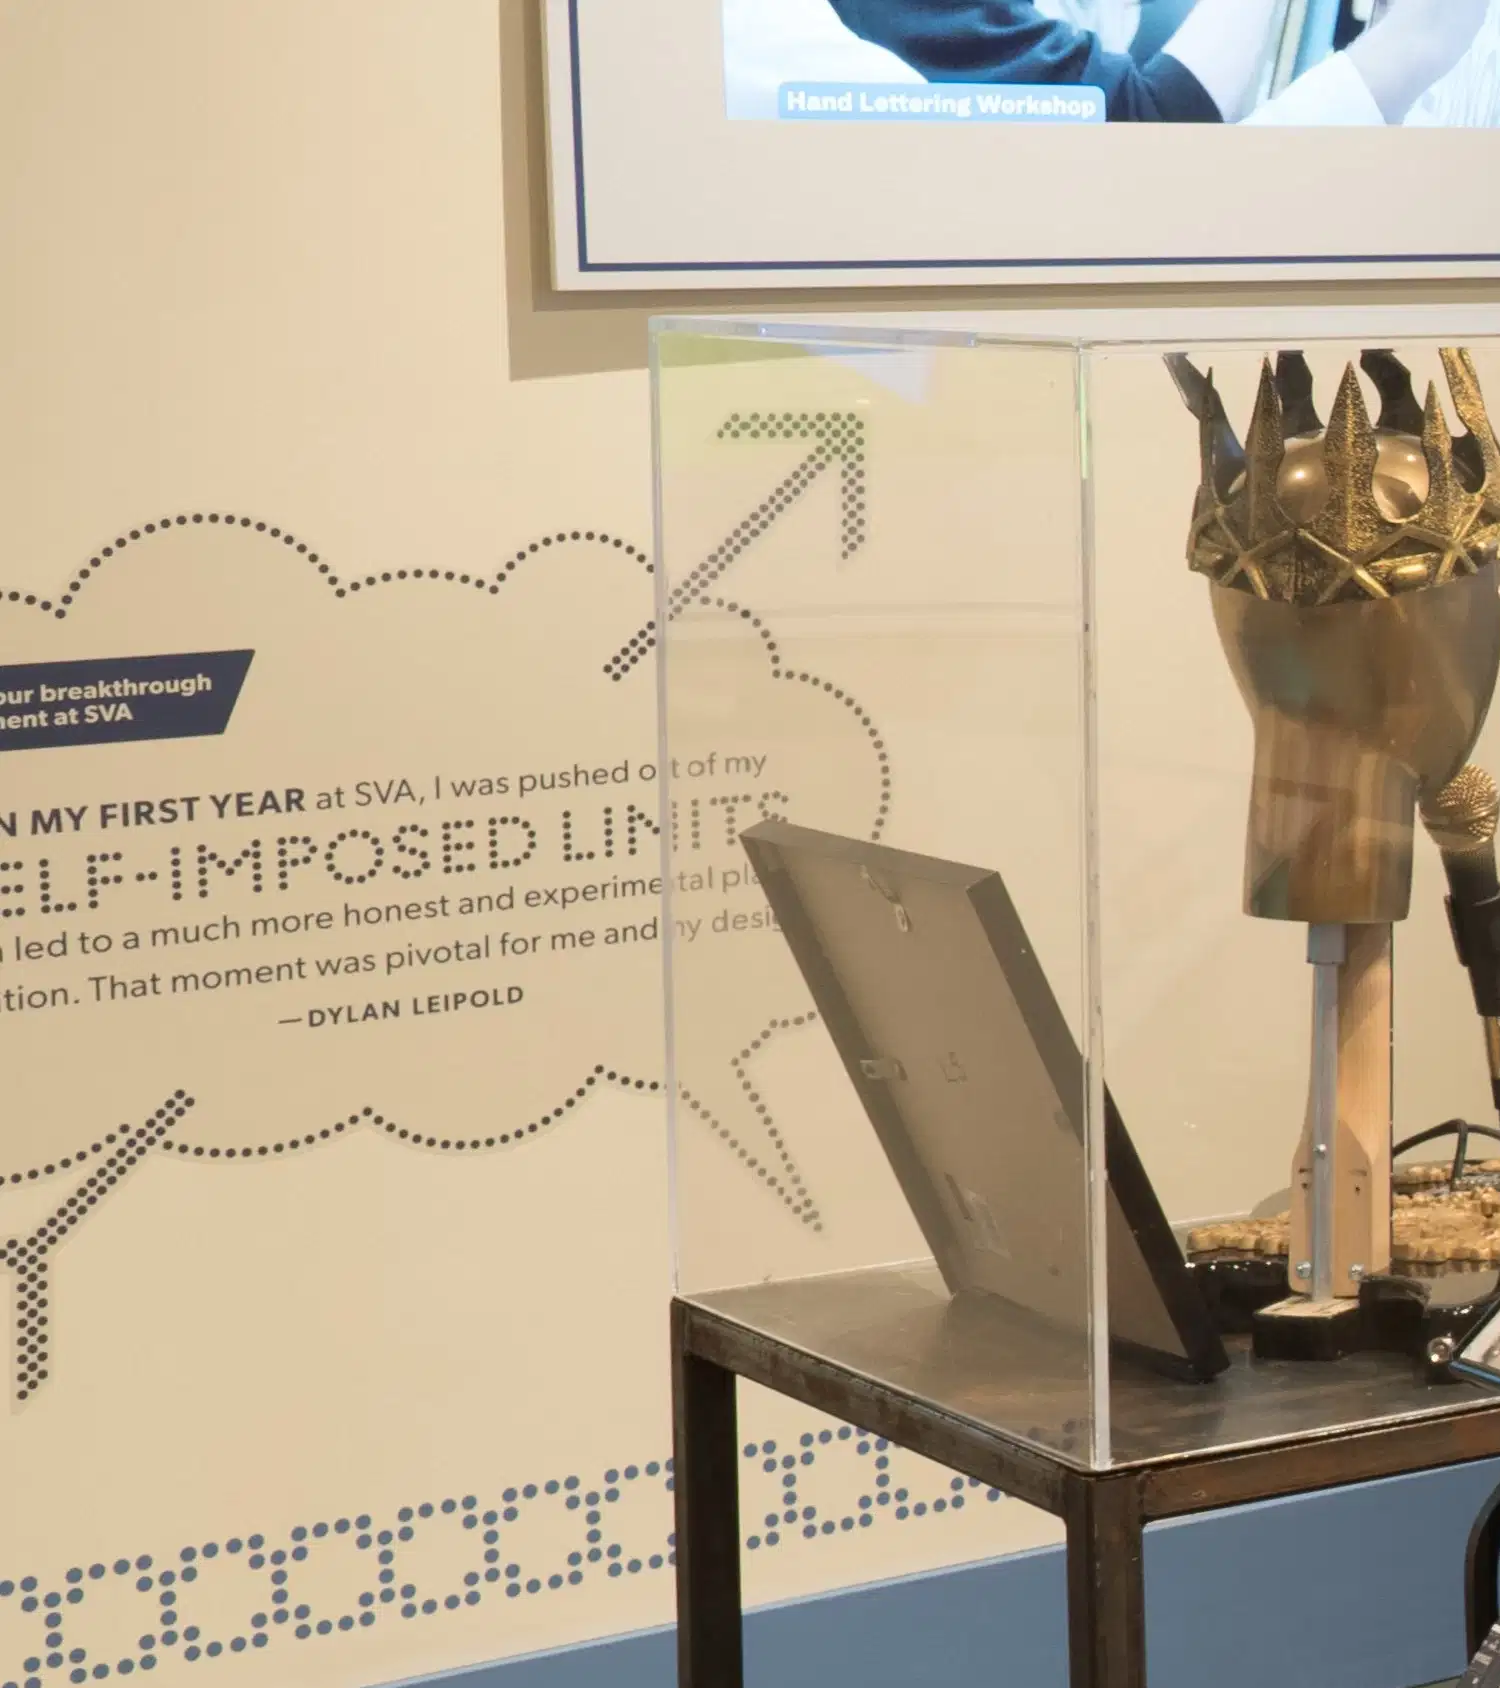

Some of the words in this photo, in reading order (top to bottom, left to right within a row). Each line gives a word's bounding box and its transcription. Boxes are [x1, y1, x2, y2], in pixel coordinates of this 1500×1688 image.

[787, 90, 852, 112] Hand
[860, 91, 971, 118] Lettering
[977, 94, 1096, 119] Workshop
[40, 674, 212, 703] breakthrough
[0, 710, 48, 730] ent
[54, 708, 79, 727] at
[84, 703, 133, 723] SVA
[31, 806, 88, 835] MY
[100, 796, 200, 829] FIRST
[210, 789, 305, 819] YEAR
[316, 786, 345, 809] at
[354, 777, 425, 806] SVA,
[435, 776, 441, 799] I
[451, 774, 510, 798] was
[519, 760, 630, 797] pushed
[639, 757, 682, 781] ot
[688, 752, 717, 778] of
[725, 753, 768, 778] my
[16, 933, 68, 962] led
[78, 931, 113, 955] to
[122, 931, 140, 950] a
[151, 916, 240, 949] much
[251, 911, 334, 937] more
[344, 896, 450, 927] honest
[458, 886, 515, 914] and
[524, 866, 713, 909] experimetal
[88, 975, 161, 1003] That
[172, 958, 306, 993] moment
[315, 953, 376, 977] was
[386, 935, 491, 974] pivotal
[500, 932, 542, 956] for
[551, 926, 595, 951] me
[604, 917, 658, 944] and
[413, 986, 524, 1016] LEIPOLD
